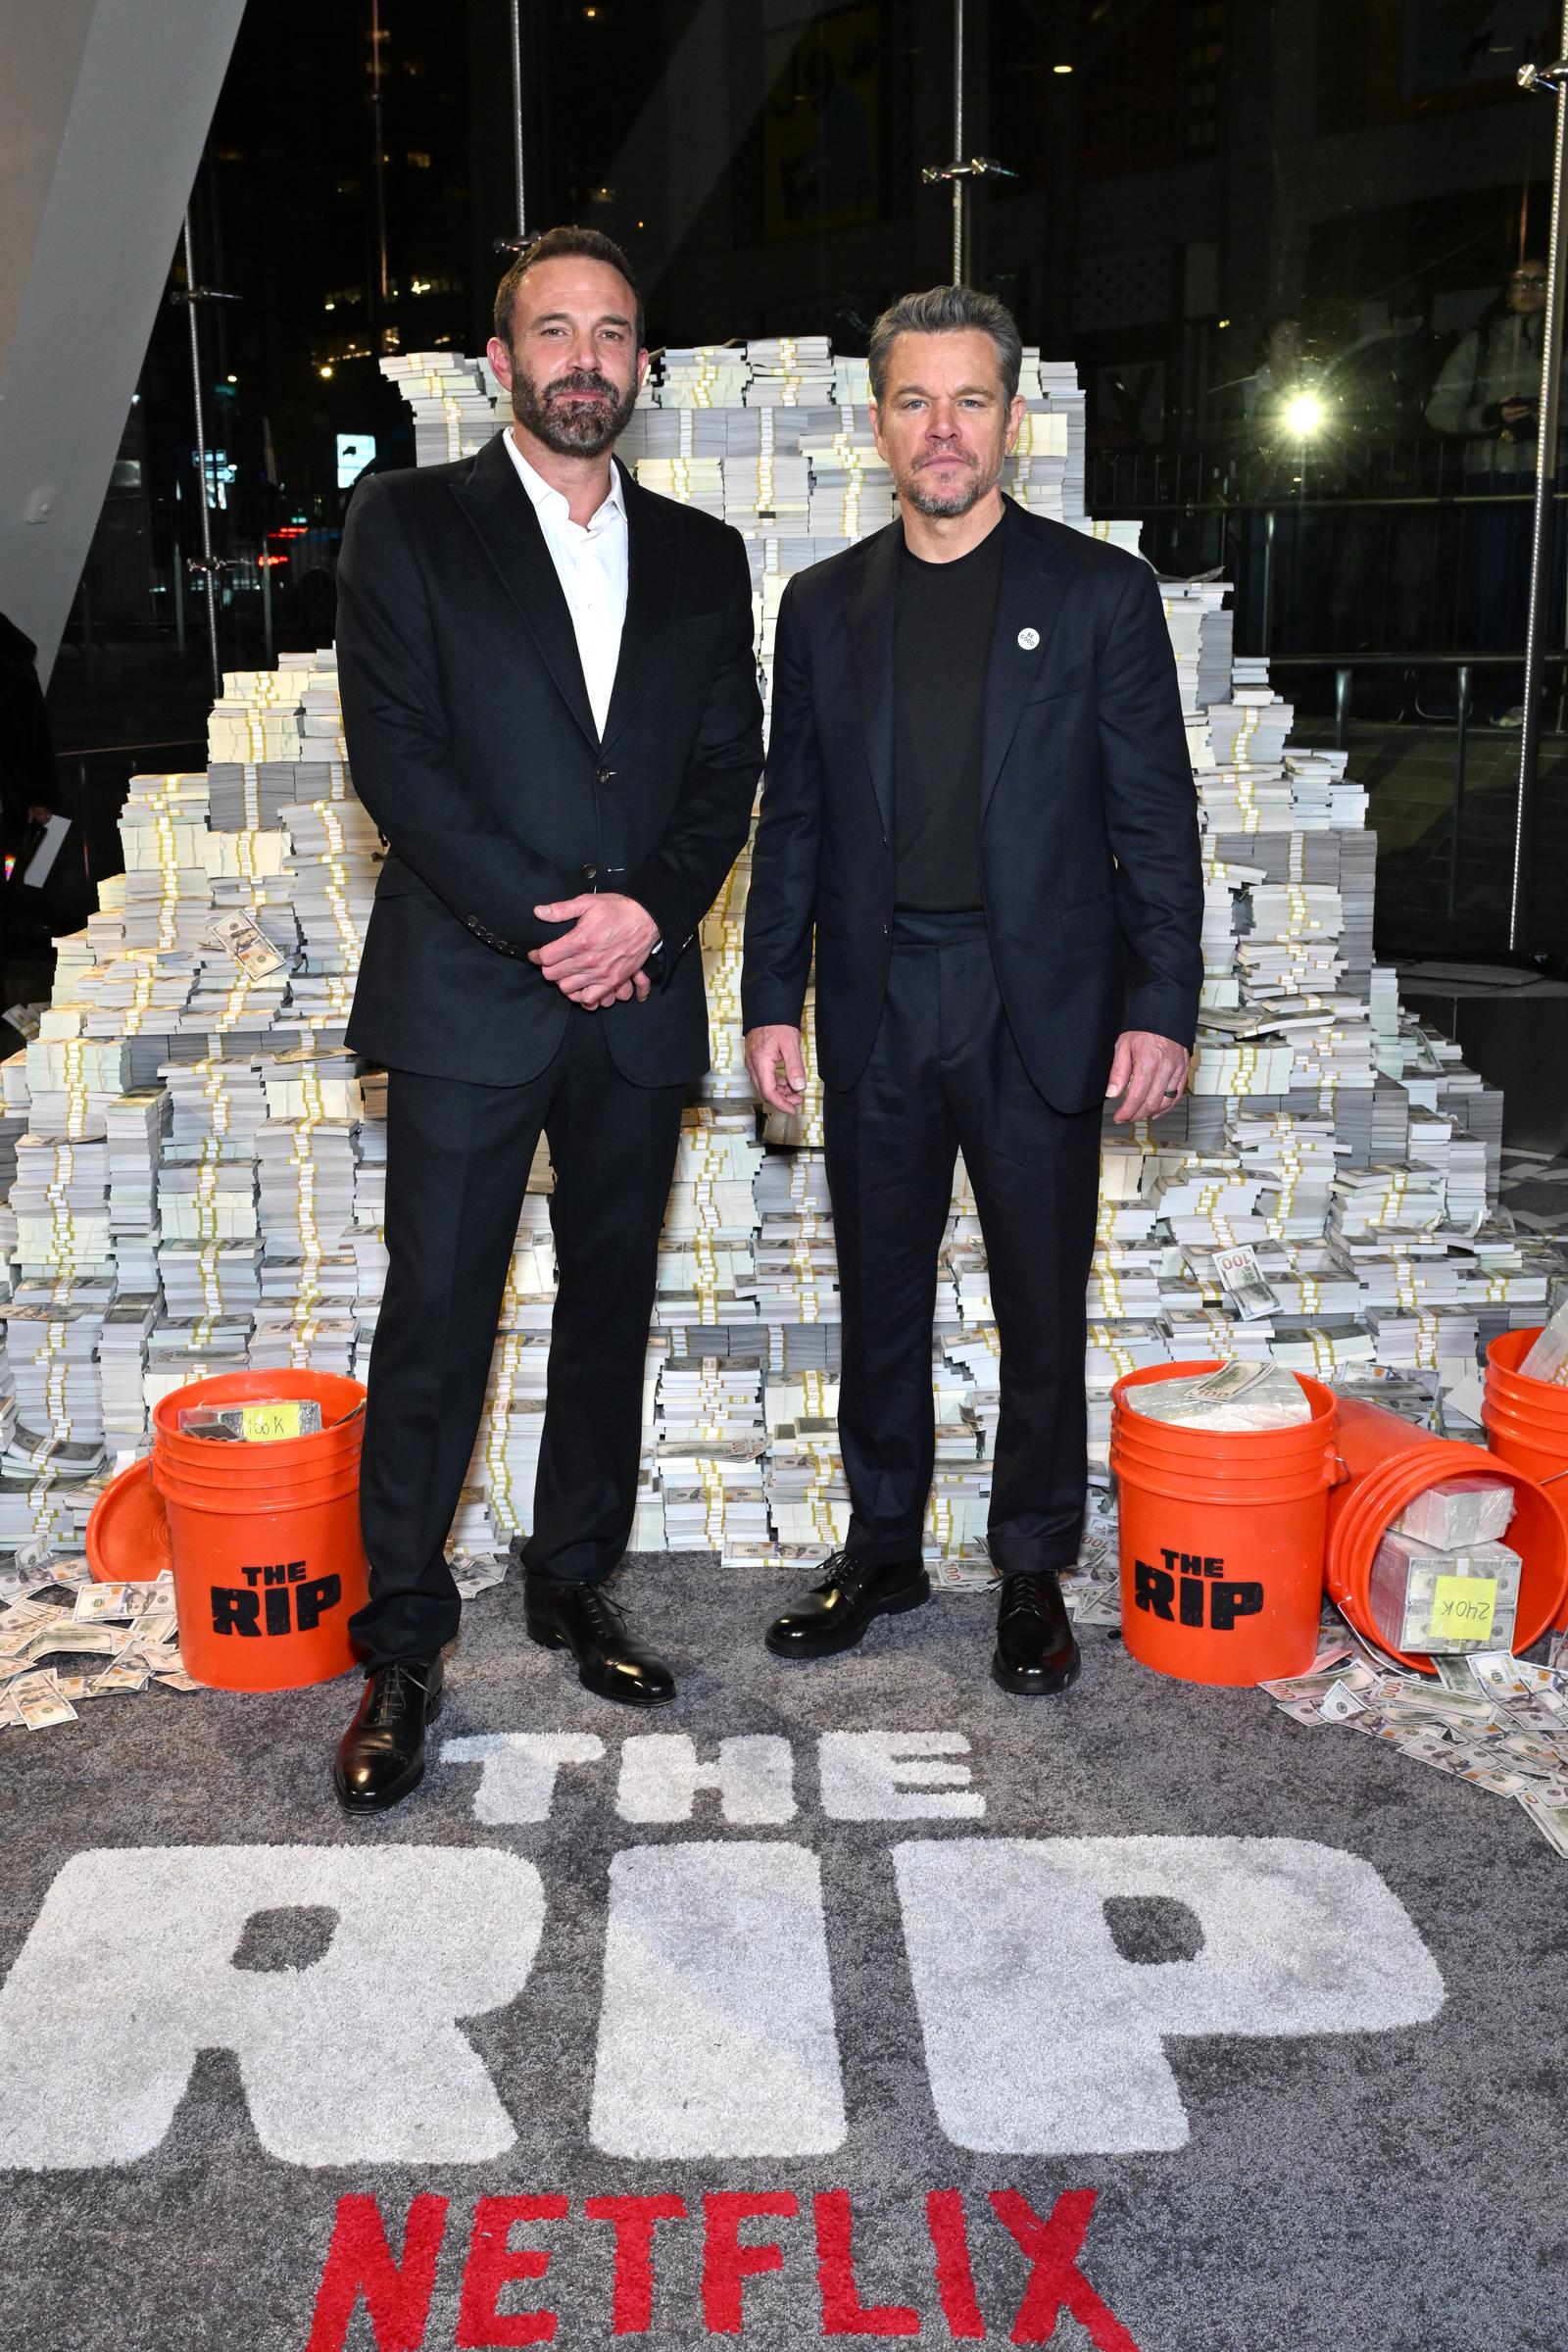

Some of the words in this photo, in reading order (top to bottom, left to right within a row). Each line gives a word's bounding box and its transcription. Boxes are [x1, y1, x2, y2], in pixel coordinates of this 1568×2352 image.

[1020, 634, 1035, 647] GOOD
[1222, 1253, 1250, 1270] 100
[241, 1560, 307, 1586] THE
[1160, 1548, 1224, 1579] THE
[211, 1573, 342, 1637] RIP
[1135, 1559, 1264, 1631] RIP
[1380, 1681, 1403, 1699] 100
[439, 1731, 987, 1826] THE
[0, 1834, 1446, 2171] RIP
[304, 2185, 1141, 2352] NETFLIX
